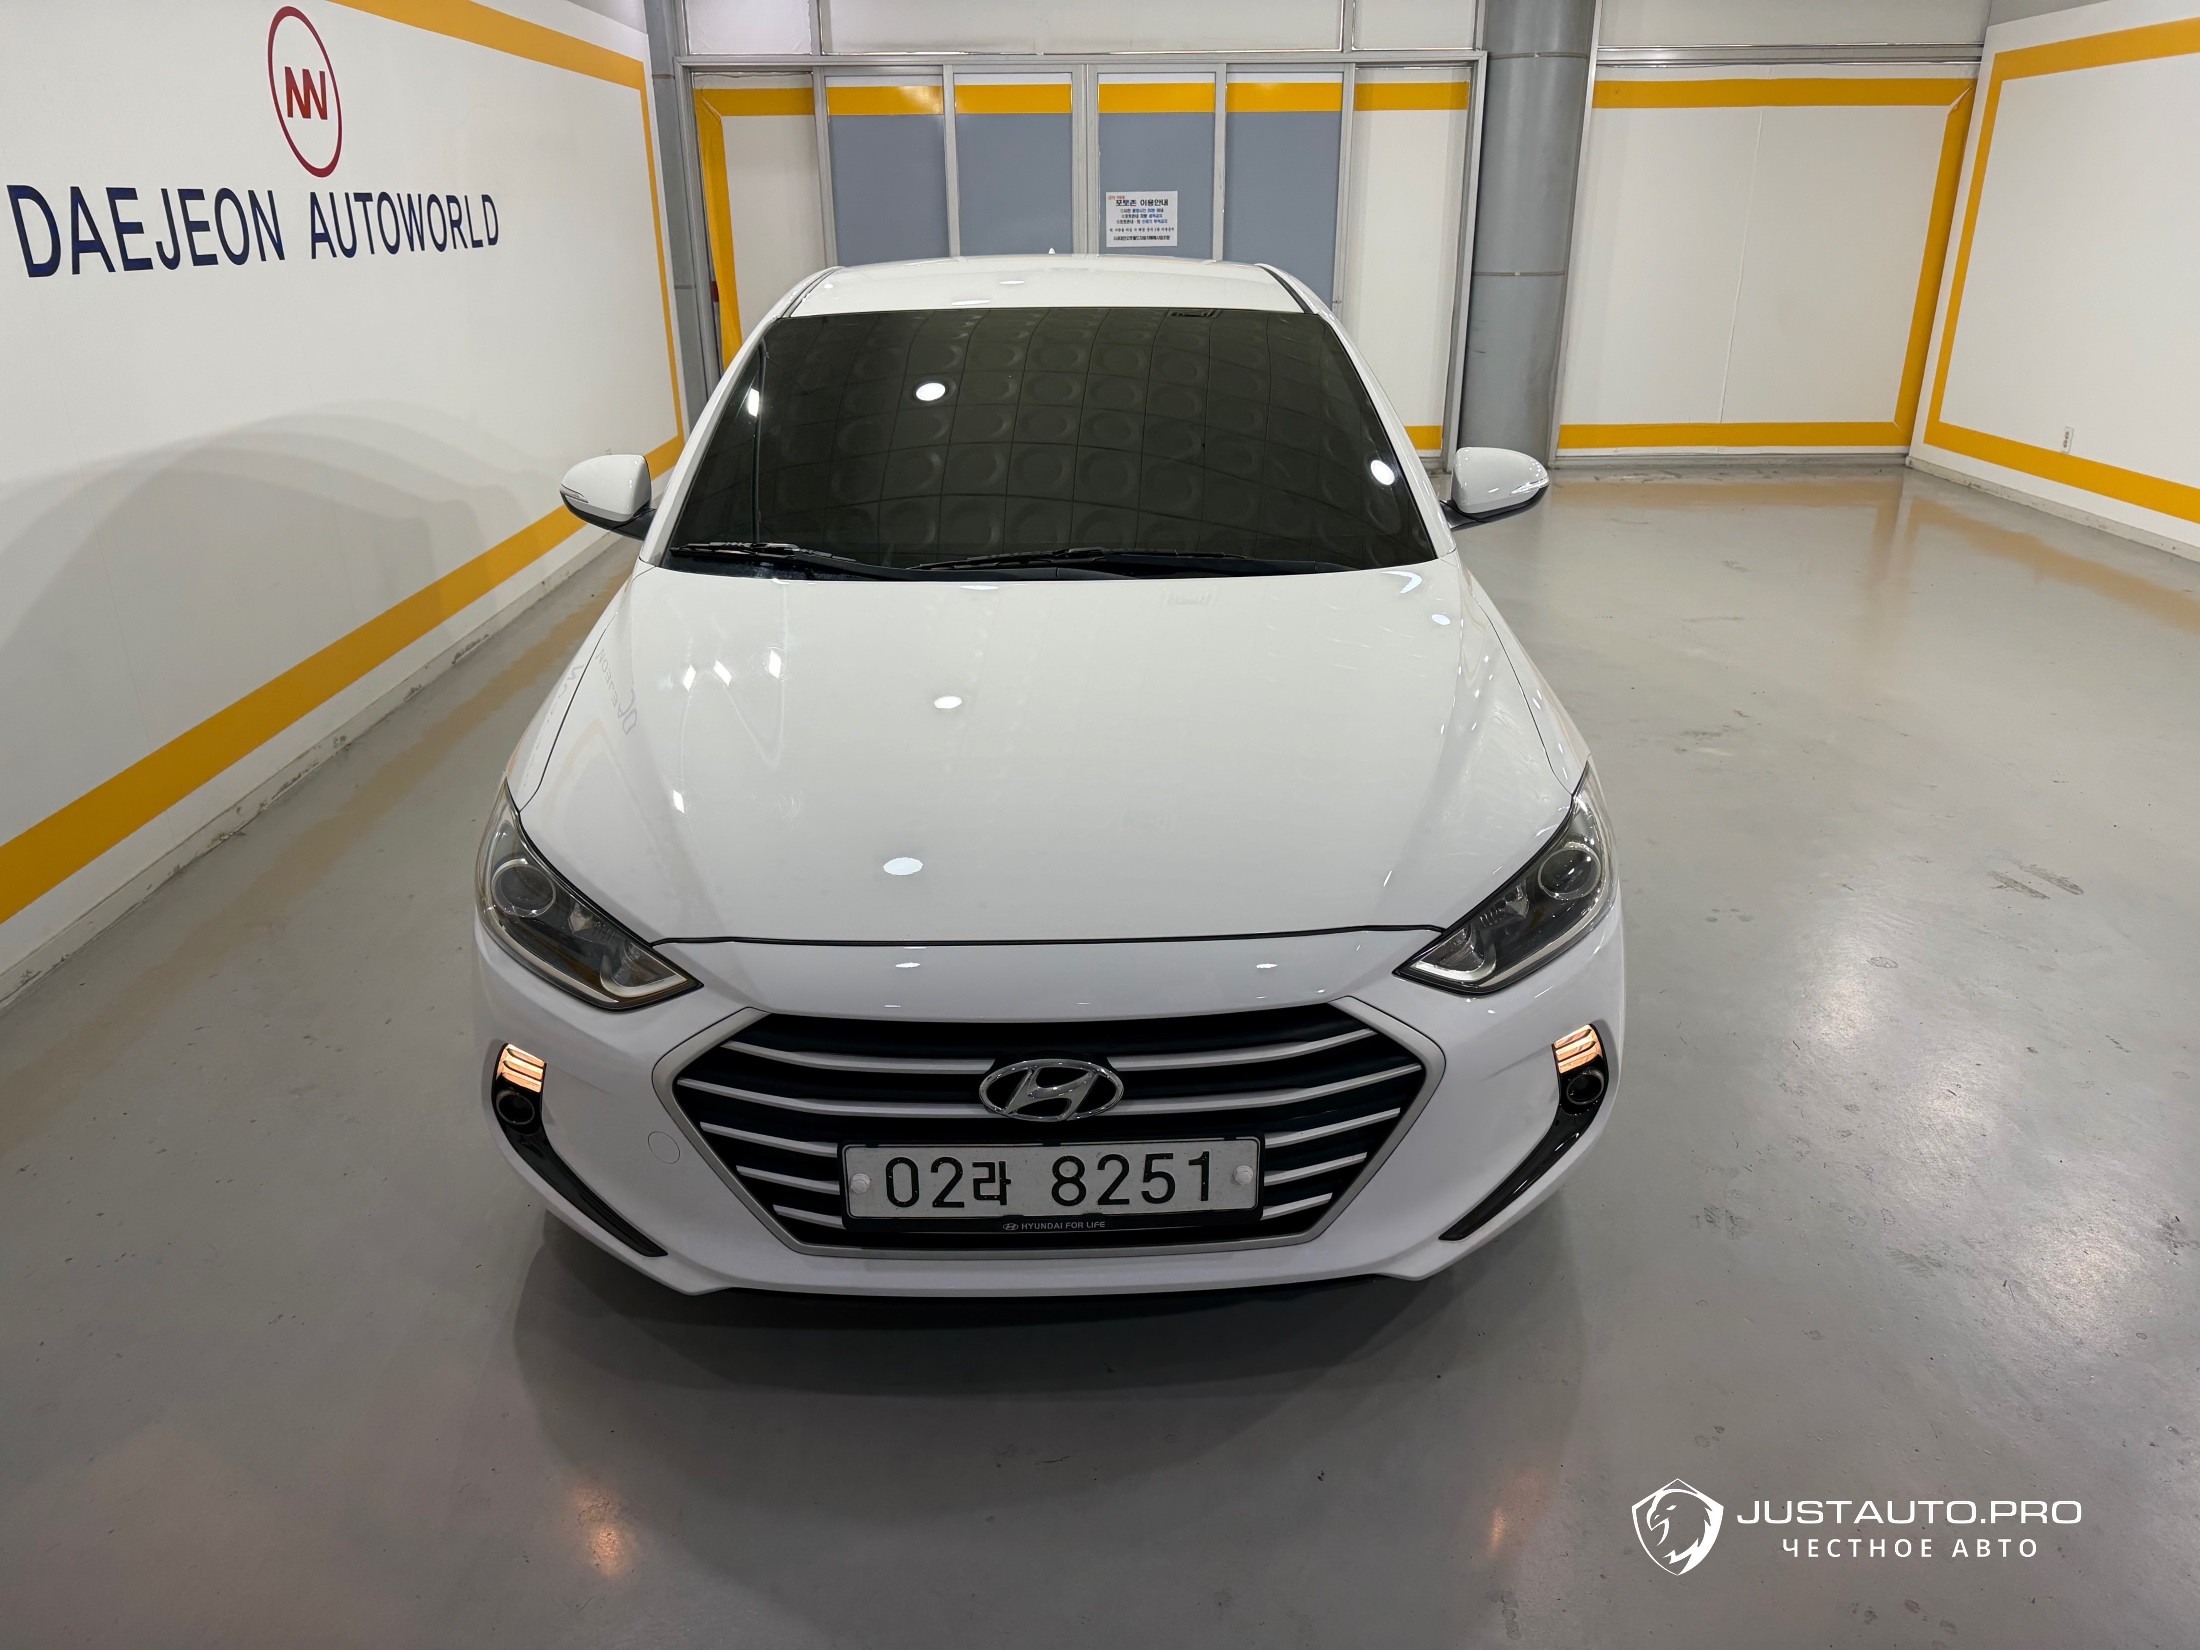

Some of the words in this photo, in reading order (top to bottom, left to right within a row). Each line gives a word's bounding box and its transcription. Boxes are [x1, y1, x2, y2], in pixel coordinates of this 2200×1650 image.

[7, 184, 285, 278] DAEJEON
[310, 191, 500, 260] AUTOWORLD
[885, 1156, 1011, 1208] 02라
[1050, 1151, 1210, 1207] 8251
[1021, 1222, 1063, 1231] HYUNDAI
[1065, 1221, 1084, 1230] FOR
[1086, 1221, 1106, 1230] LIFE
